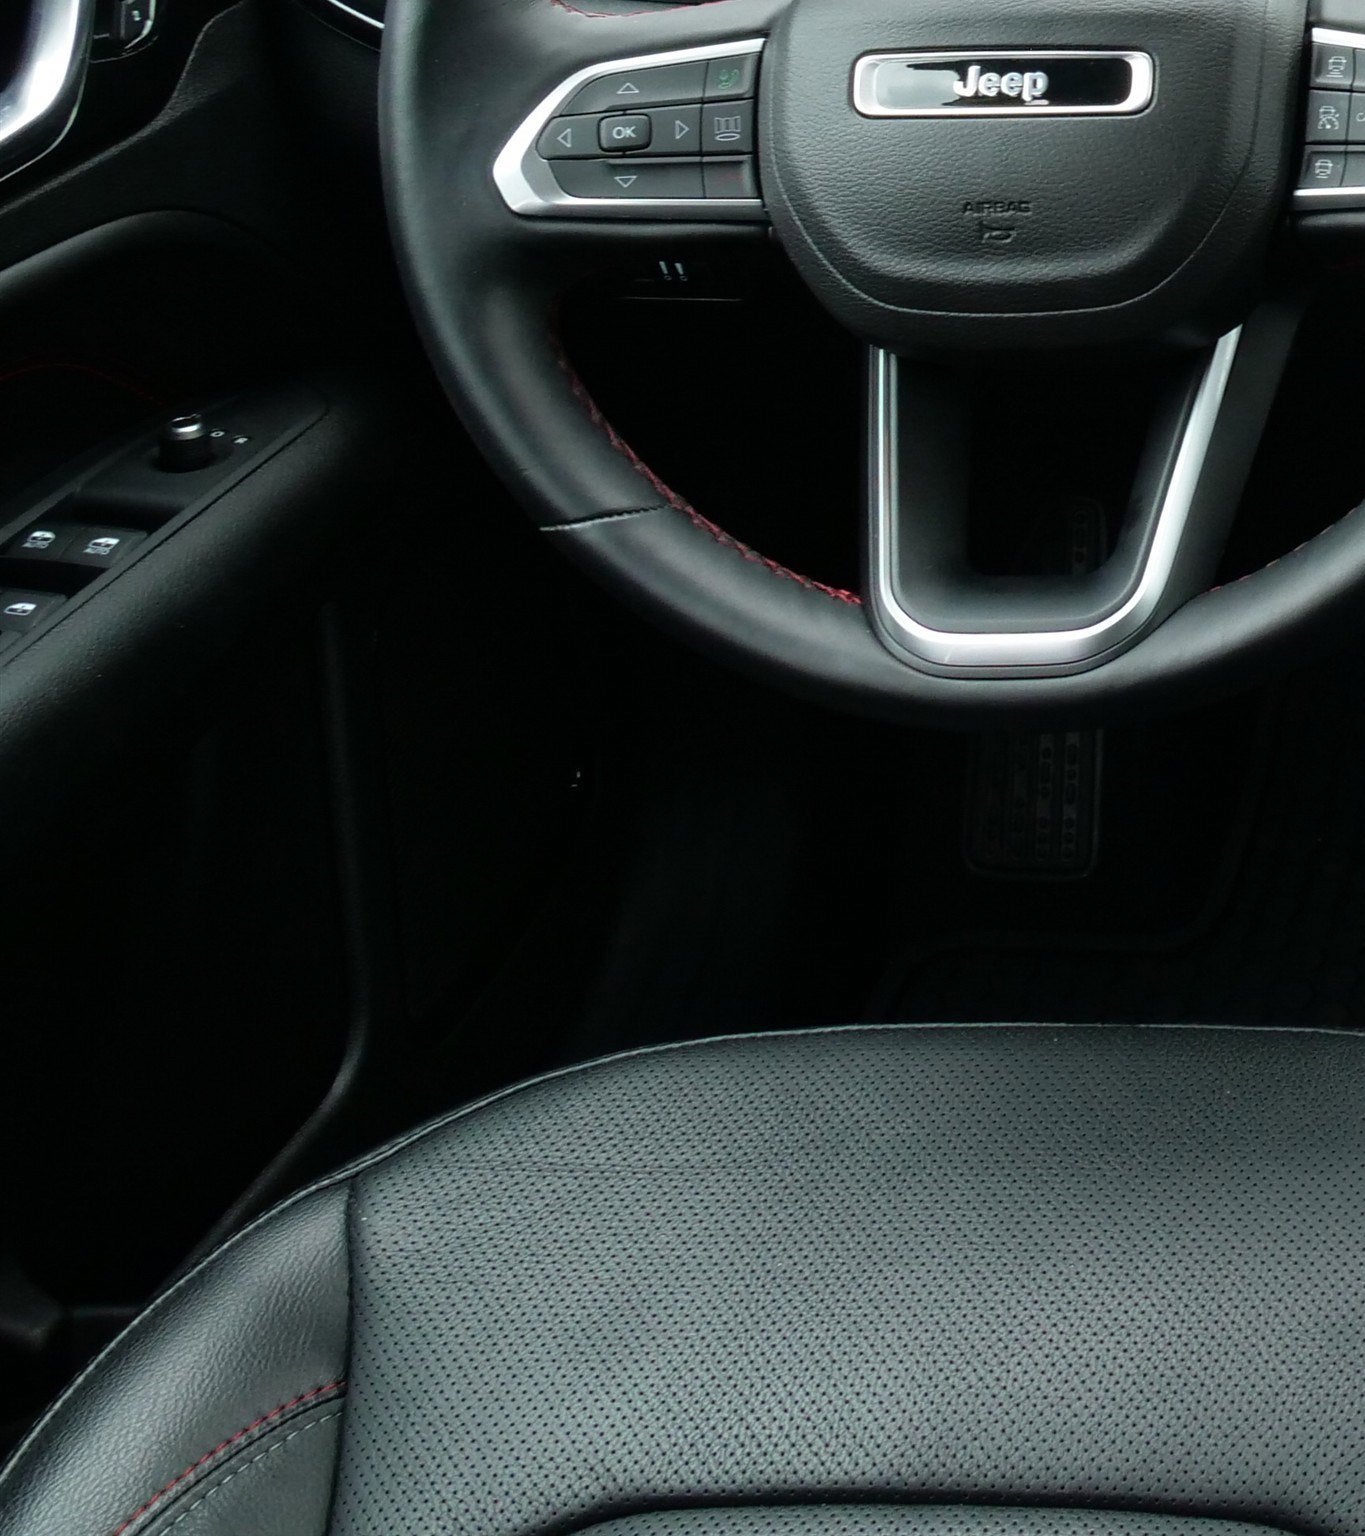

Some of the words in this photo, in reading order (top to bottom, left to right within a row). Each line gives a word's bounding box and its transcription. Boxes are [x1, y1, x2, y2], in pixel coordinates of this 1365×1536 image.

[953, 65, 1049, 102] Jeep
[612, 126, 636, 140] OK
[963, 201, 1032, 214] AIRBAG
